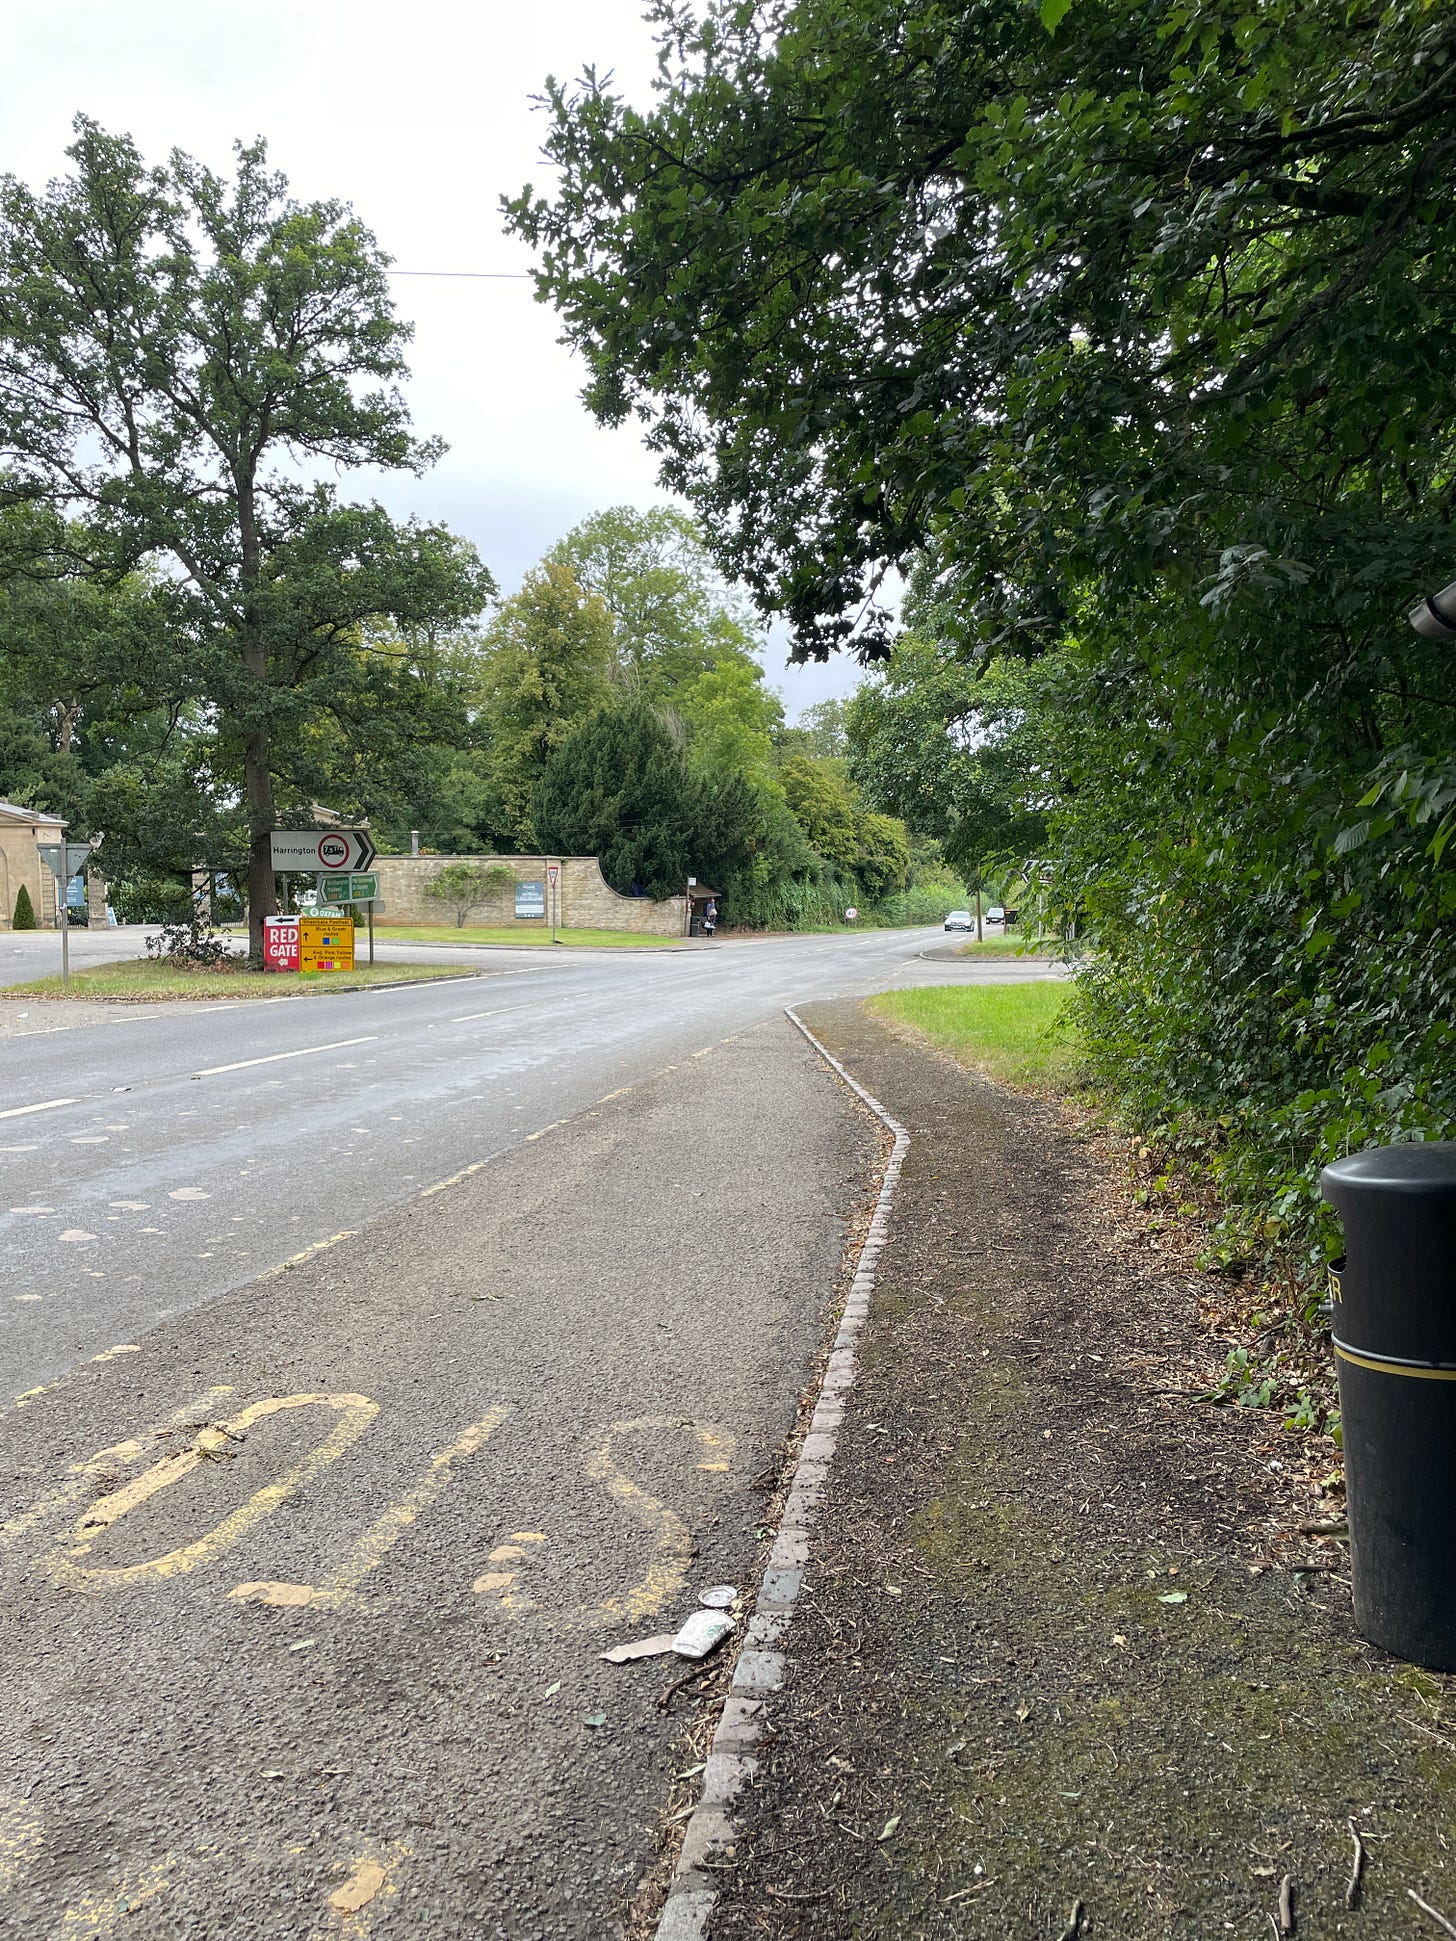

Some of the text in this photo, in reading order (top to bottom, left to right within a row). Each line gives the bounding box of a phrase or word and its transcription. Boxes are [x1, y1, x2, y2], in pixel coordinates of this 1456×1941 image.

[273, 846, 316, 856] Harrington
[270, 928, 298, 943] RED
[270, 945, 298, 957] GATE
